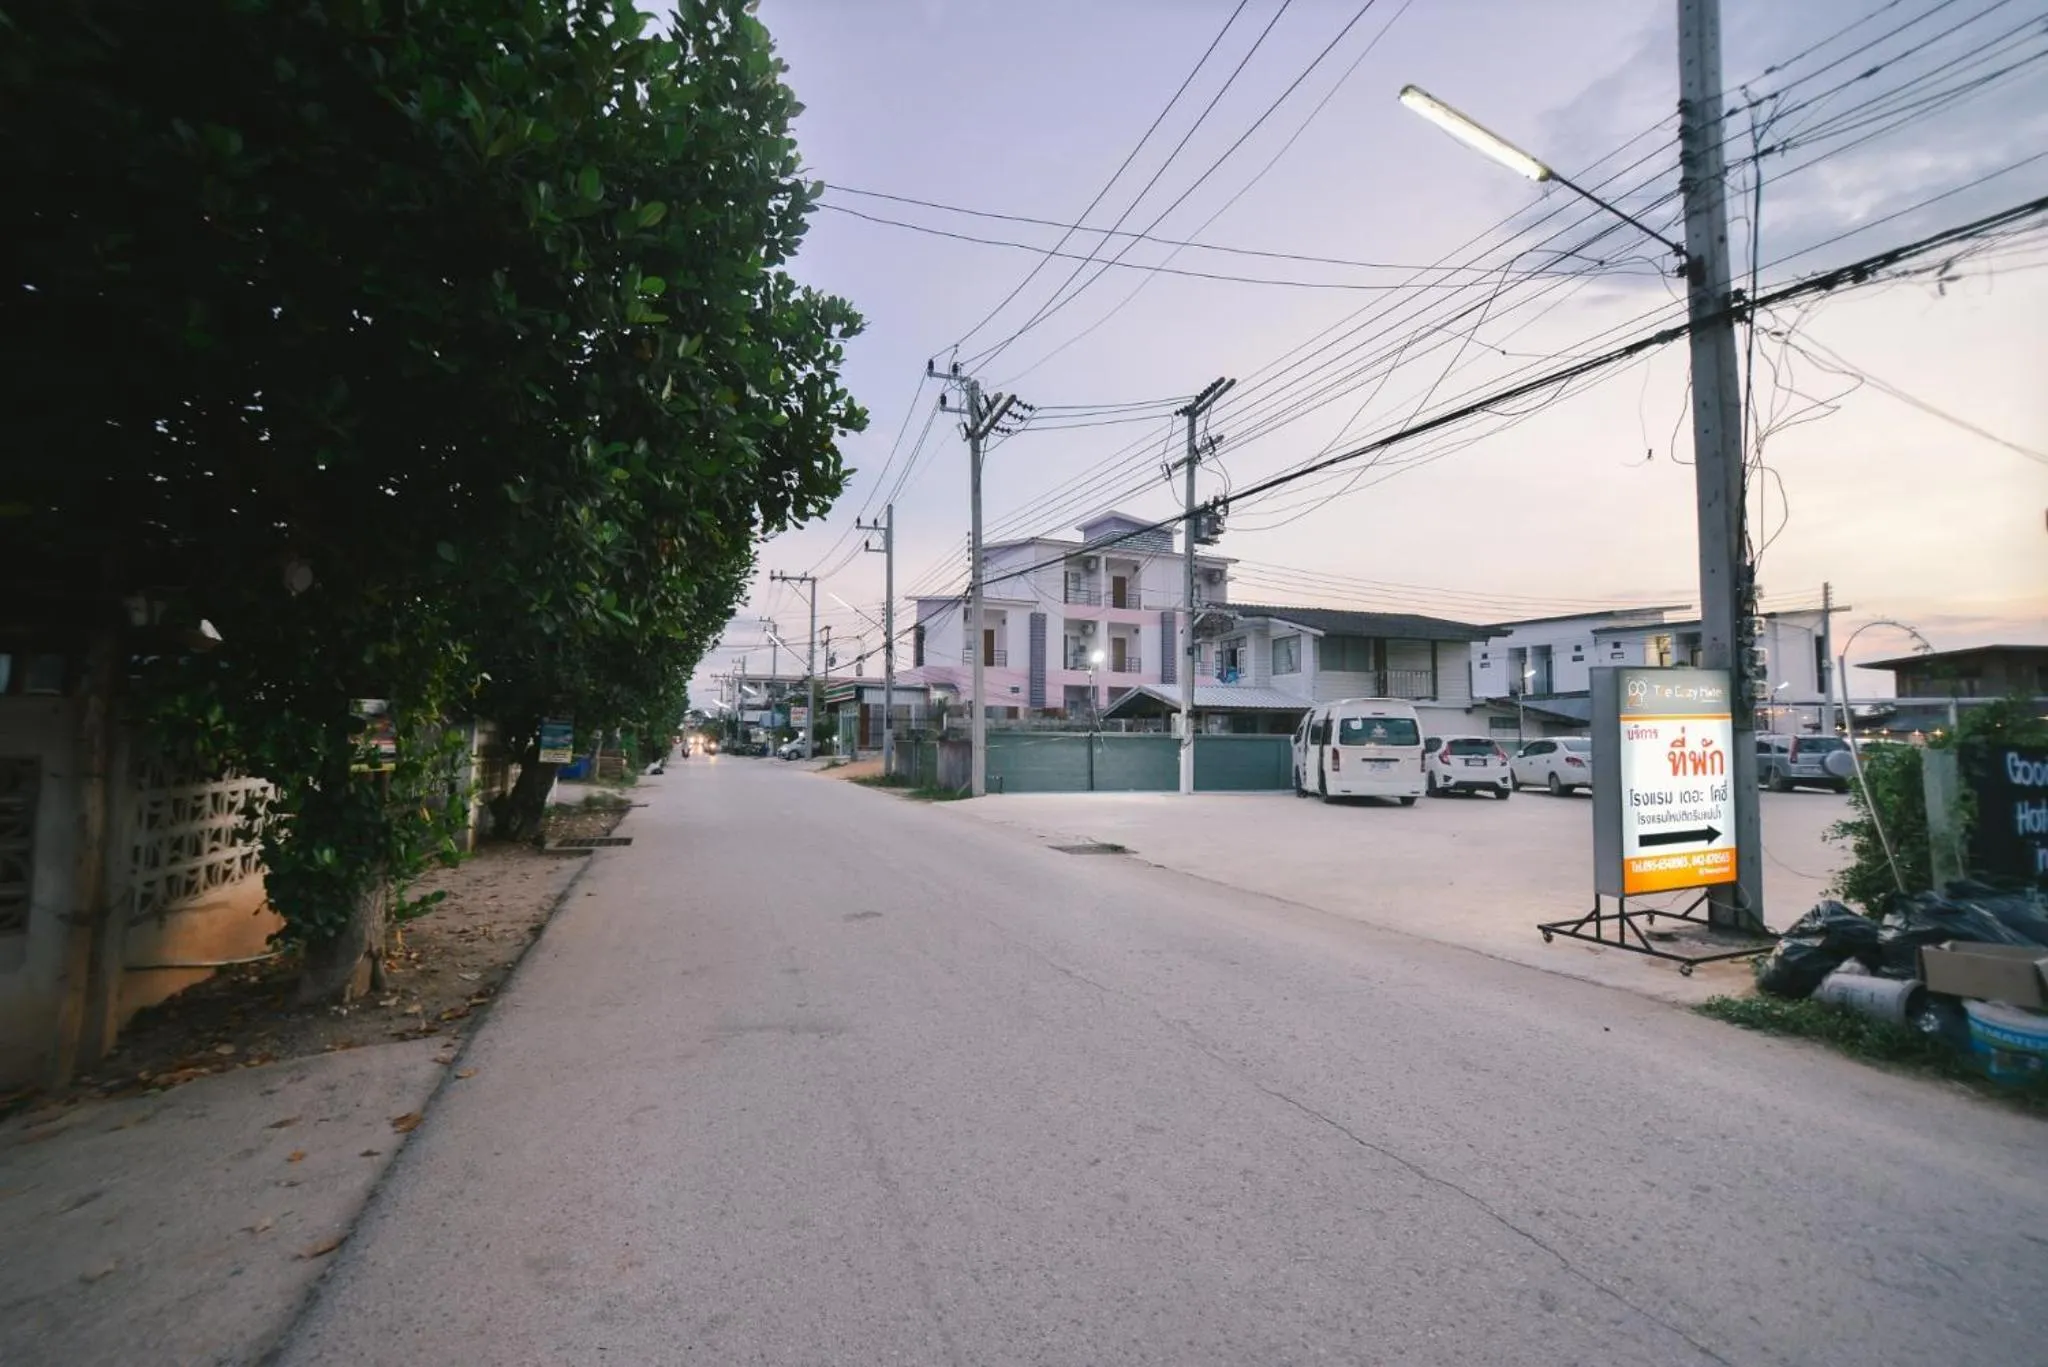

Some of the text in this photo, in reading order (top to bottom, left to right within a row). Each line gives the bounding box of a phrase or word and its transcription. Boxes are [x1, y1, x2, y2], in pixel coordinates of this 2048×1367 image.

[1667, 726, 1725, 777] ที่พัก
[1629, 788, 1673, 807] โรงแรม
[1680, 789, 1704, 804] เดอะ
